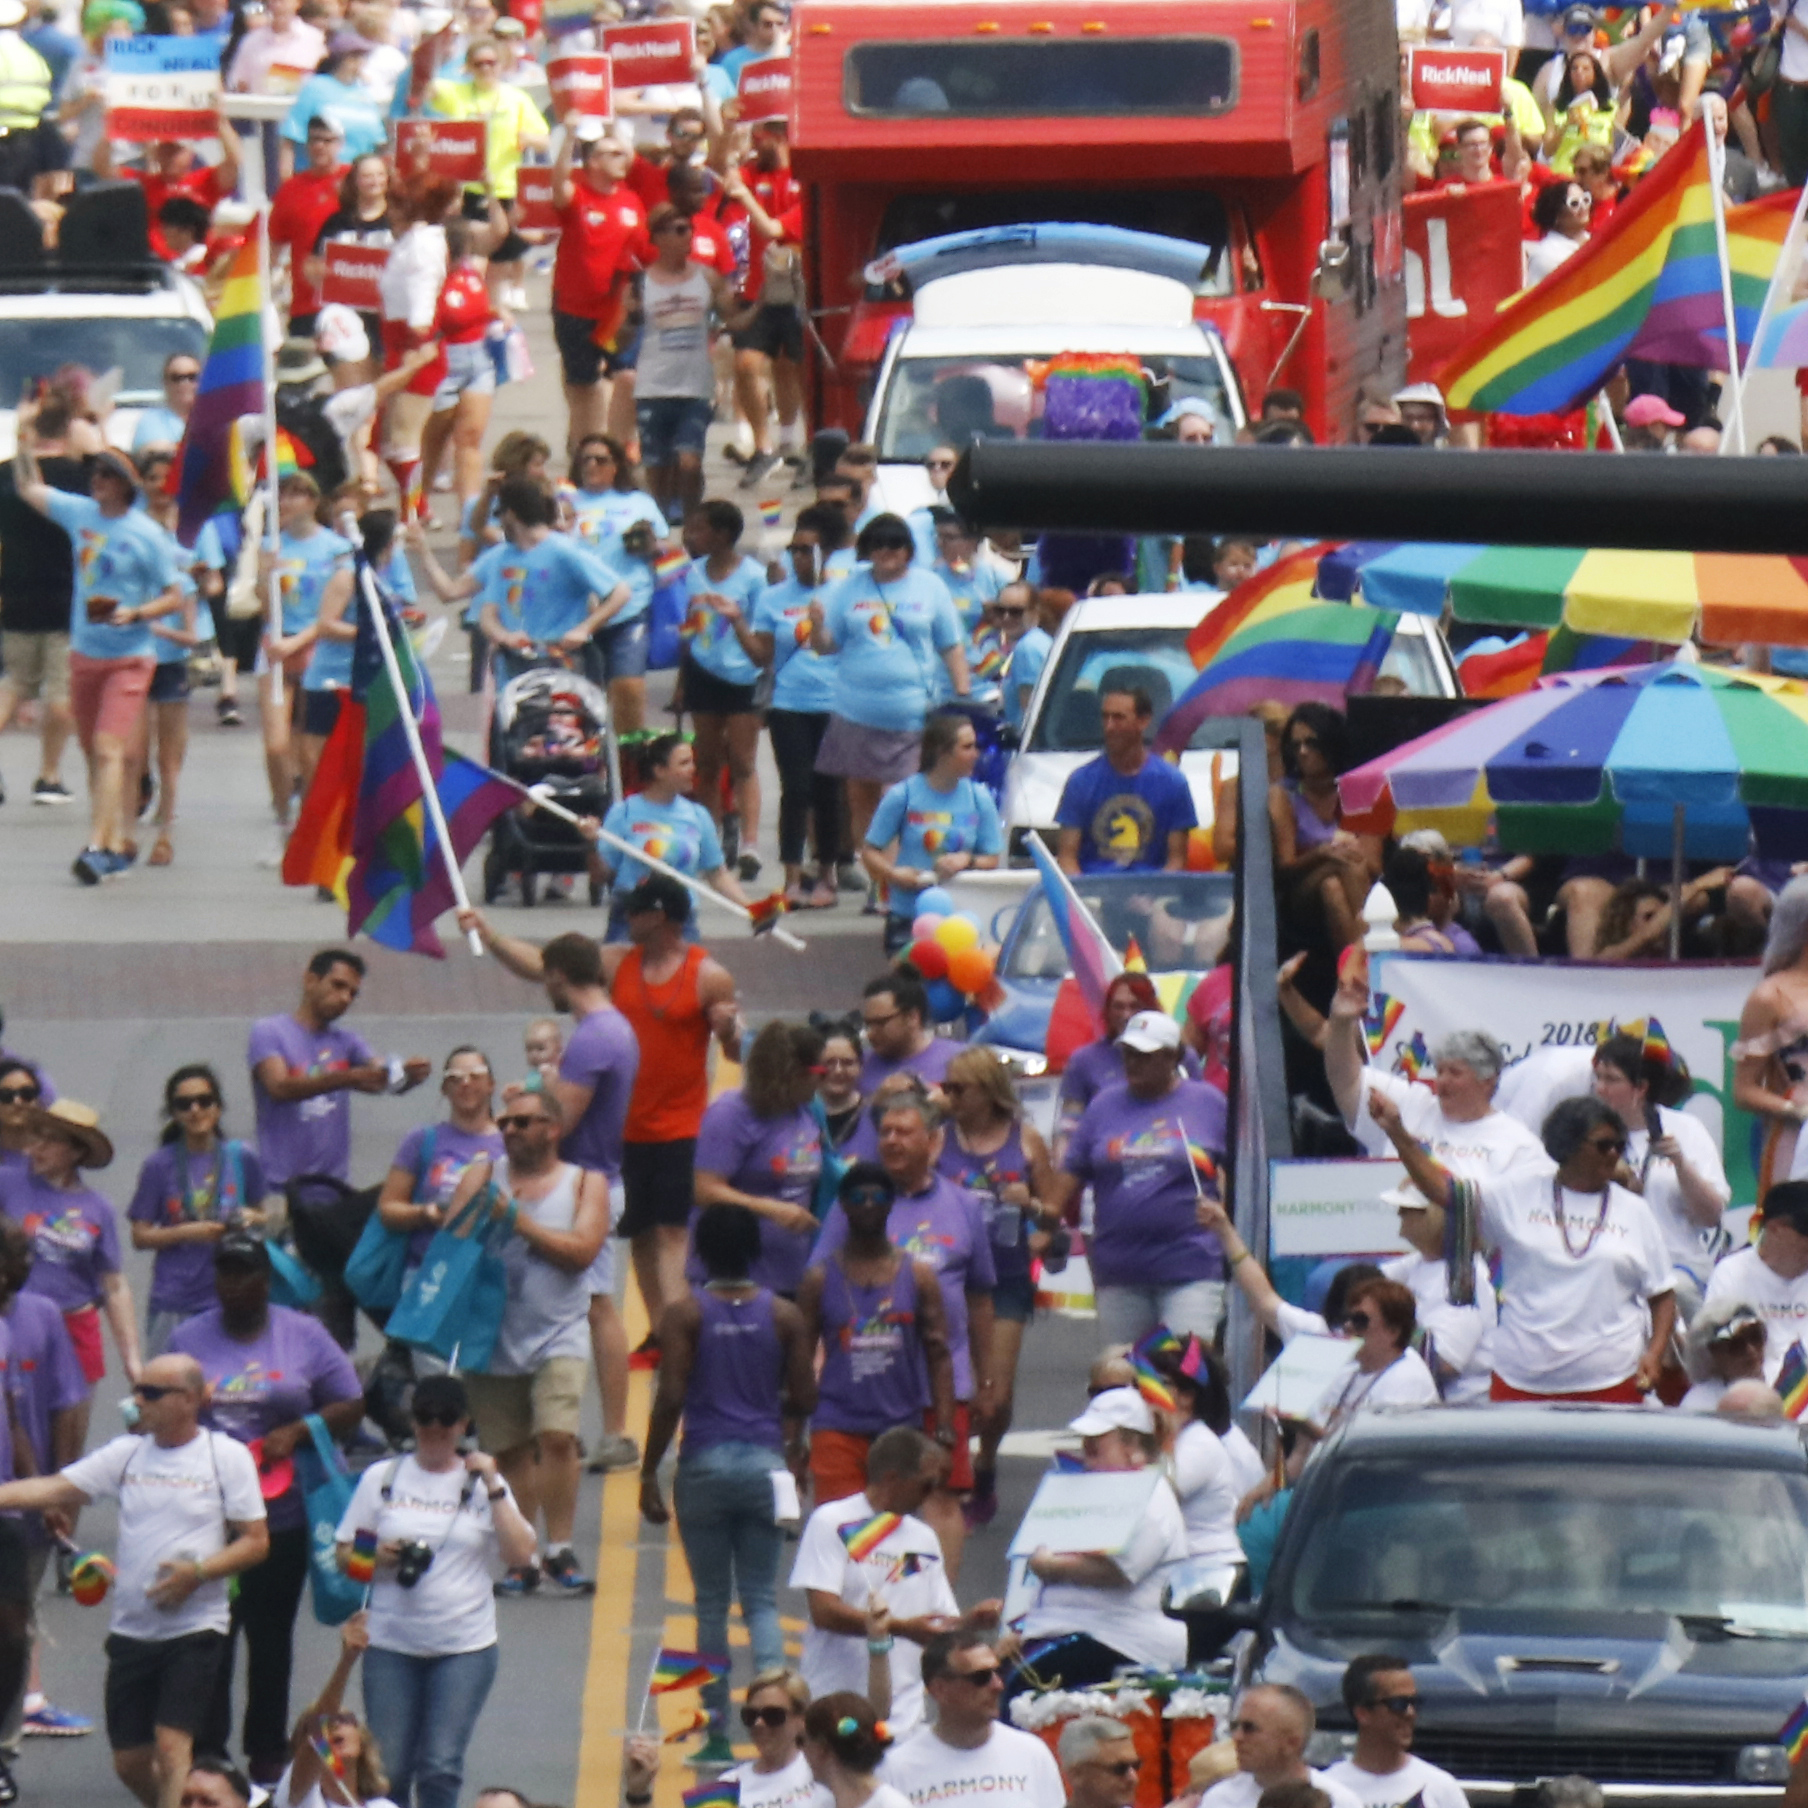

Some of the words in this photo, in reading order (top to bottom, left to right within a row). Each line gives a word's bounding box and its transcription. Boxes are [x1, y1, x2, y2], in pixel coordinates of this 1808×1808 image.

[1420, 65, 1492, 87] RickNeal
[1542, 1021, 1598, 1046] 2018
[909, 1774, 1029, 1805] HARMONY
